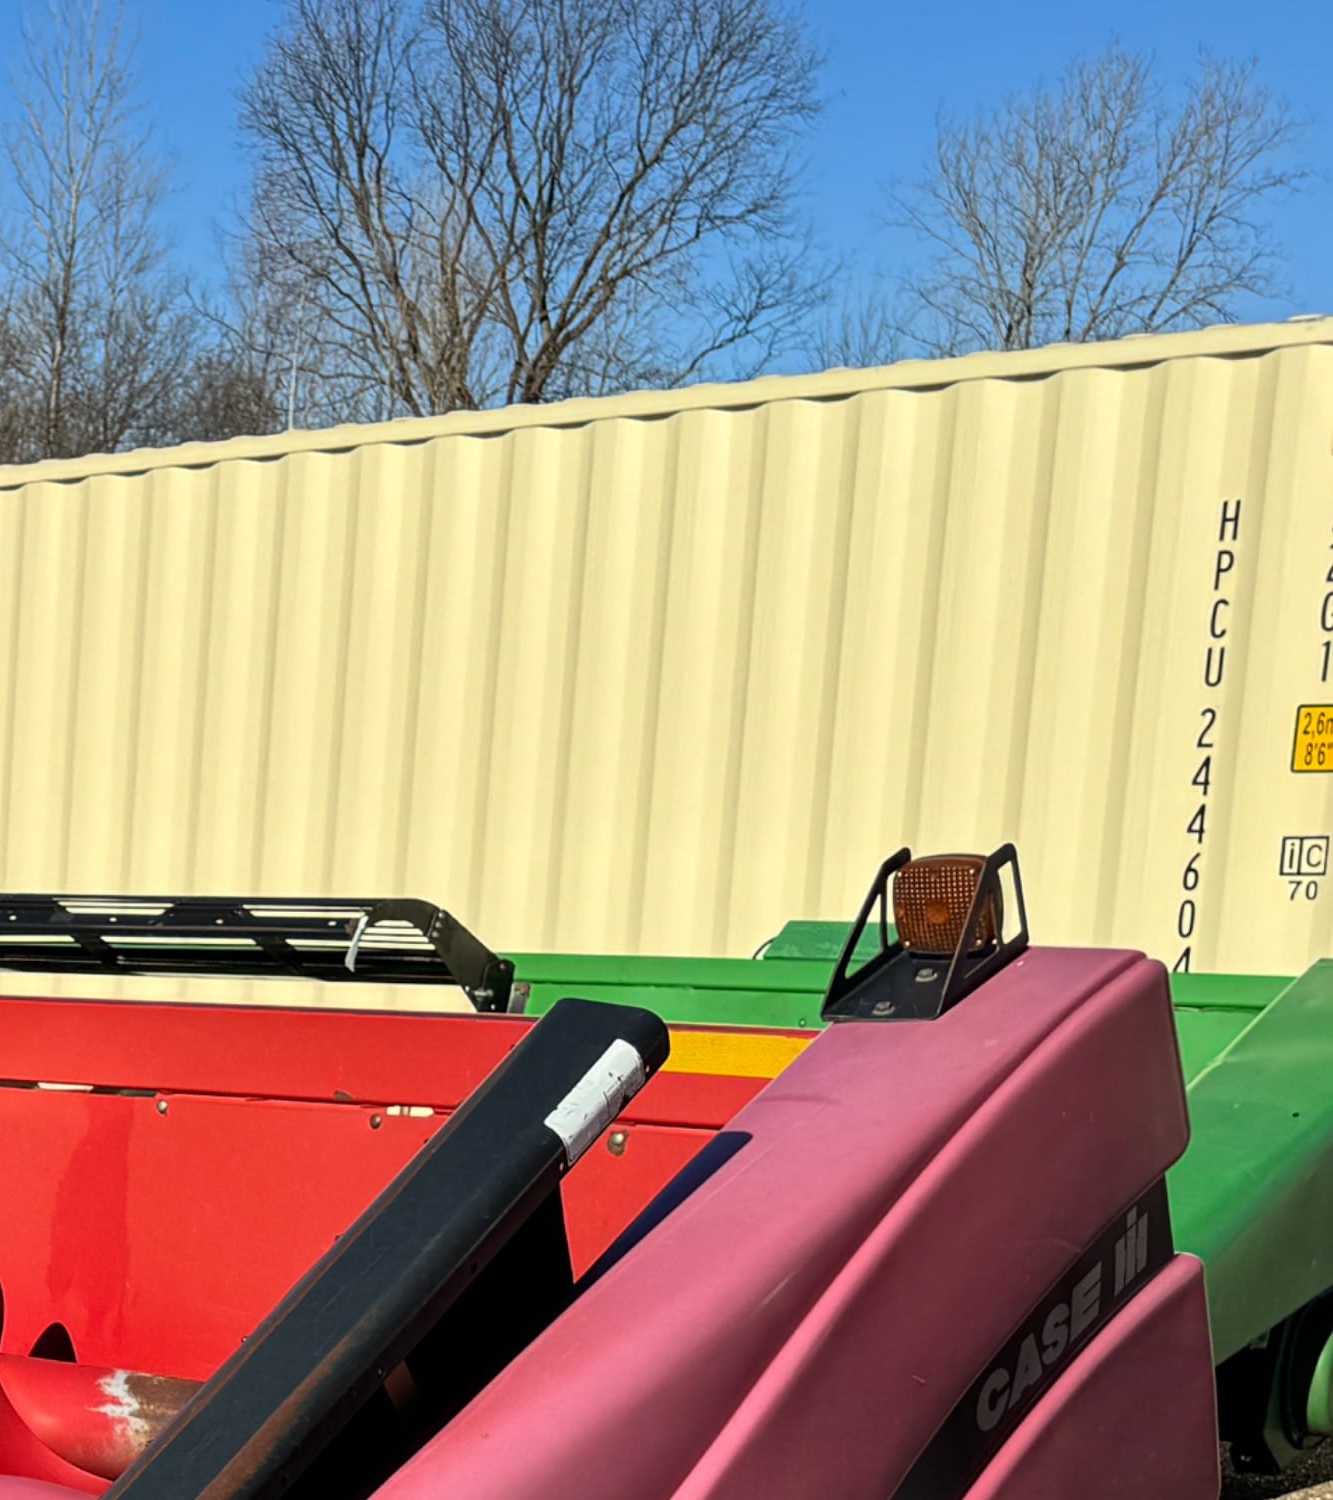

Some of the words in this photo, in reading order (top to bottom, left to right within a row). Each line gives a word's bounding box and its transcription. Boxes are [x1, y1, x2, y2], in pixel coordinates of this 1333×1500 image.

[1205, 499, 1241, 687] HPCU
[1288, 880, 1319, 901] 70
[975, 1260, 1102, 1432] CASE
